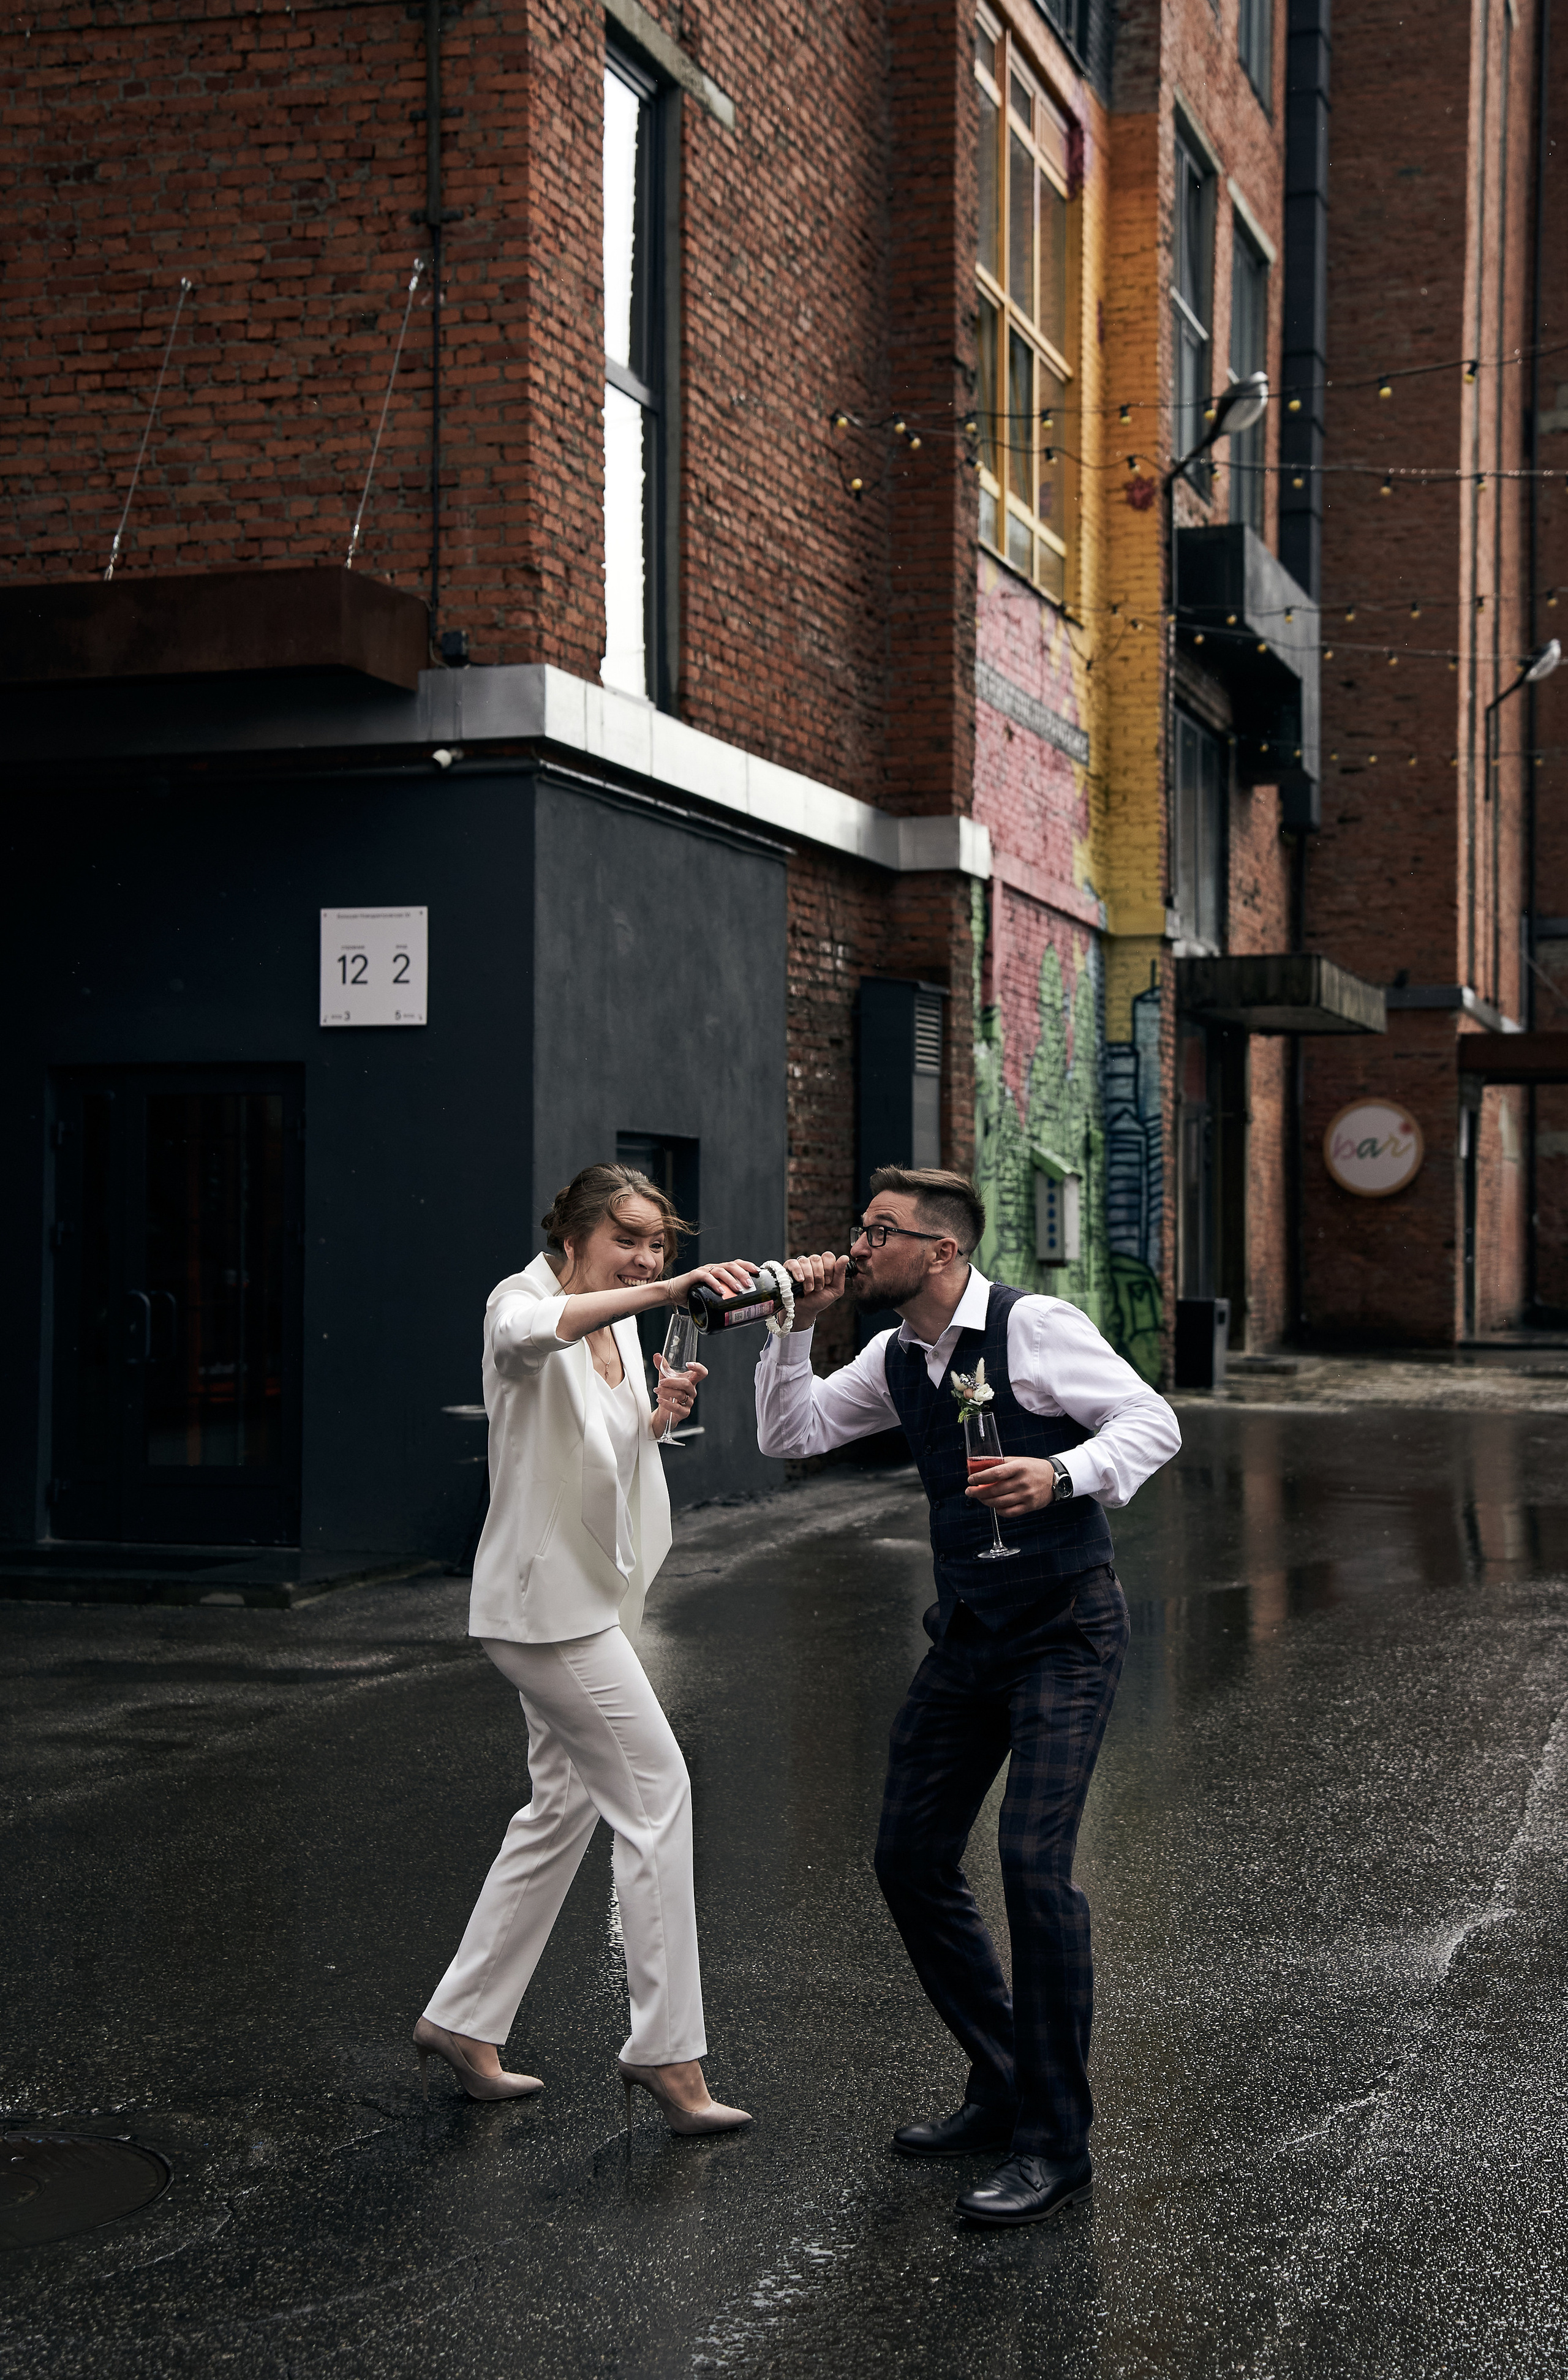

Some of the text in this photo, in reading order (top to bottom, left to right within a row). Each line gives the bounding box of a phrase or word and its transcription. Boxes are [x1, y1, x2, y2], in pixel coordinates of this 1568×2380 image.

[337, 954, 369, 985] 12
[393, 953, 410, 984] 2
[344, 1011, 351, 1022] 3
[1333, 1132, 1412, 1161] bar
